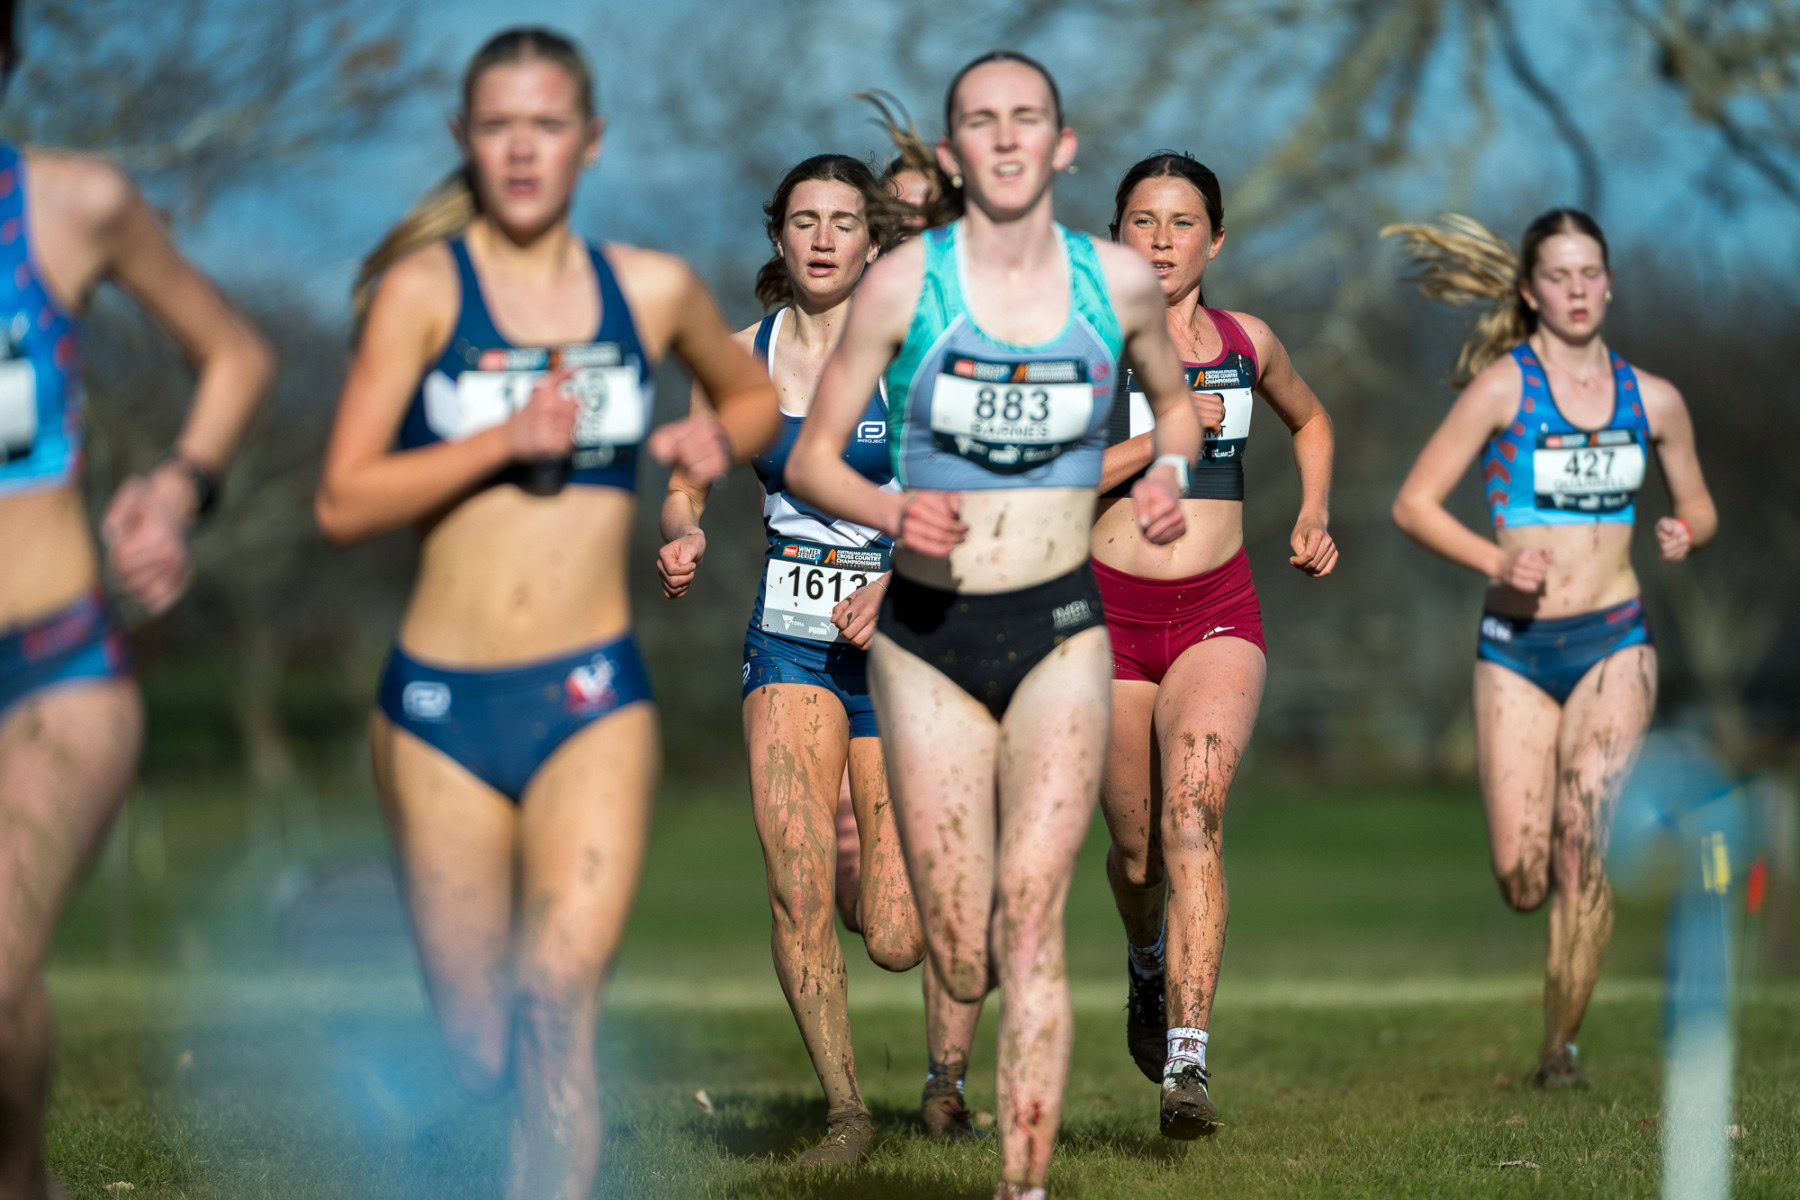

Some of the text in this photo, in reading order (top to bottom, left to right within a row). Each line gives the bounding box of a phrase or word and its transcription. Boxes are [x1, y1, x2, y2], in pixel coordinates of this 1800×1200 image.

[976, 388, 1049, 422] 883
[1564, 449, 1617, 478] 427
[798, 545, 821, 555] WINTER
[836, 558, 881, 567] CHAMPIONSHIPS
